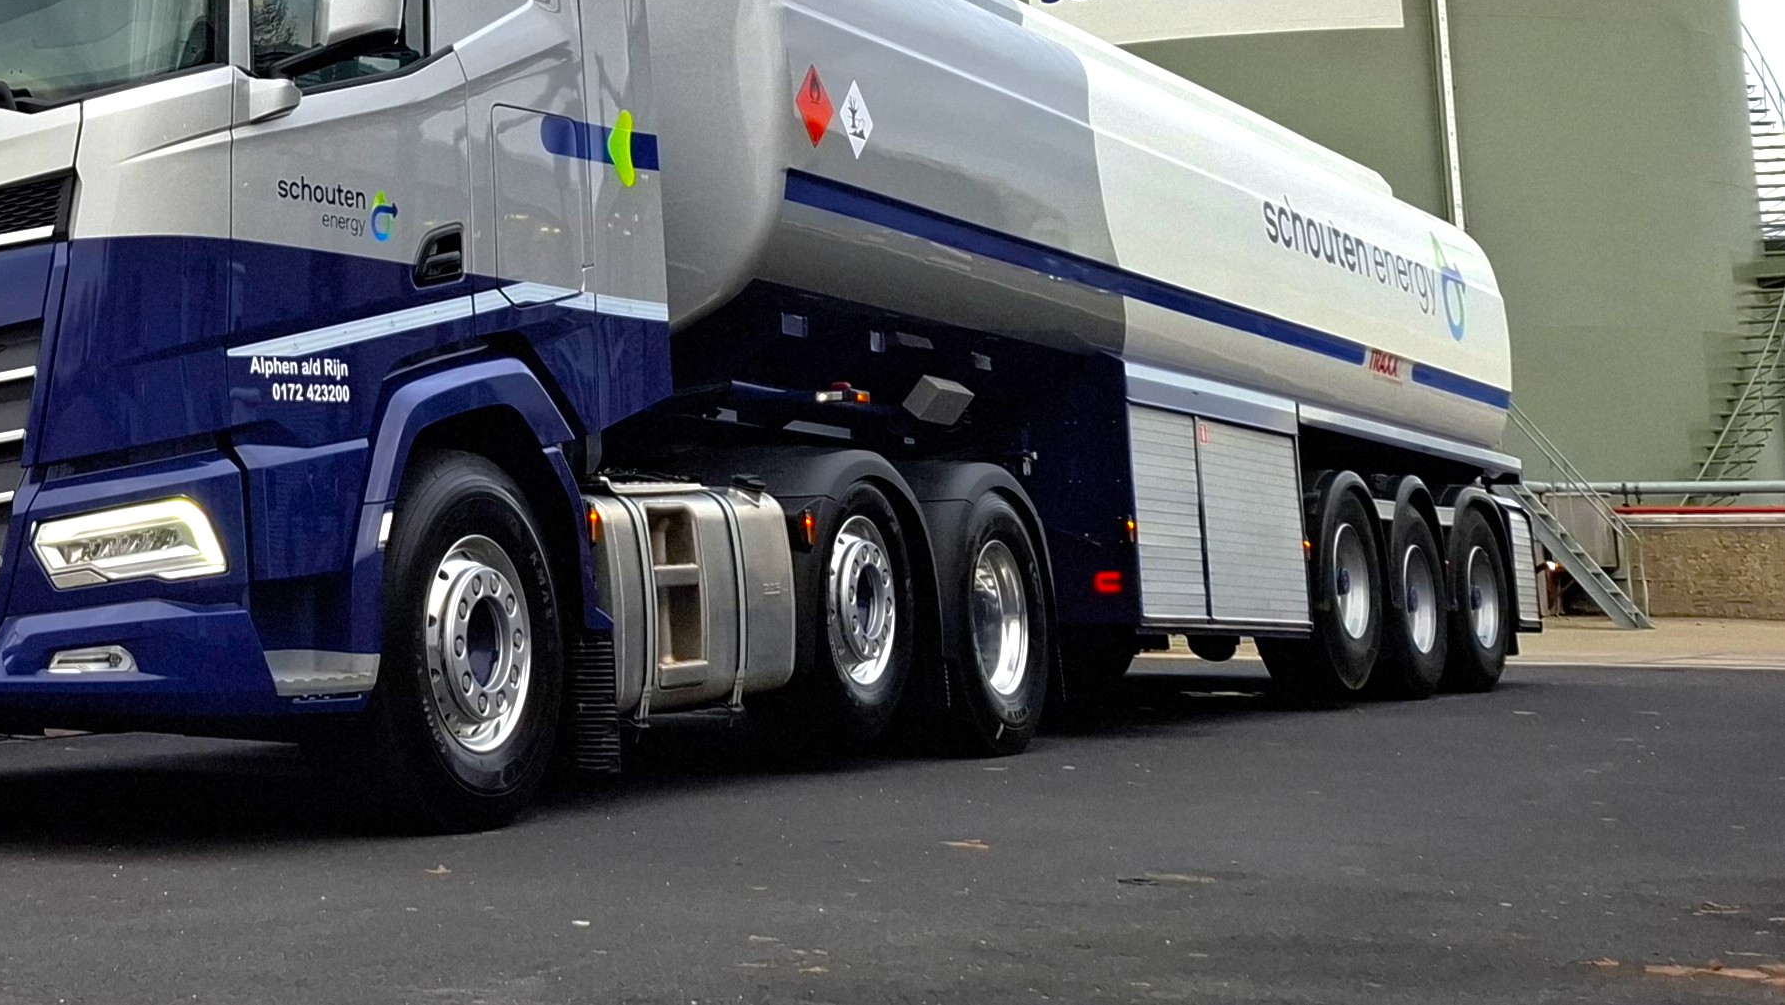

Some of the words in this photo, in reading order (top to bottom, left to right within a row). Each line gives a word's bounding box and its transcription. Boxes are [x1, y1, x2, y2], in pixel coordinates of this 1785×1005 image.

[278, 175, 366, 210] schouten
[322, 213, 366, 237] energy
[1263, 194, 1370, 278] schouten
[1372, 244, 1437, 316] energy
[250, 356, 298, 378] Alphen
[301, 357, 321, 375] a/d
[324, 358, 349, 381] Rijn
[272, 383, 304, 401] 0172
[306, 383, 350, 403] 423200
